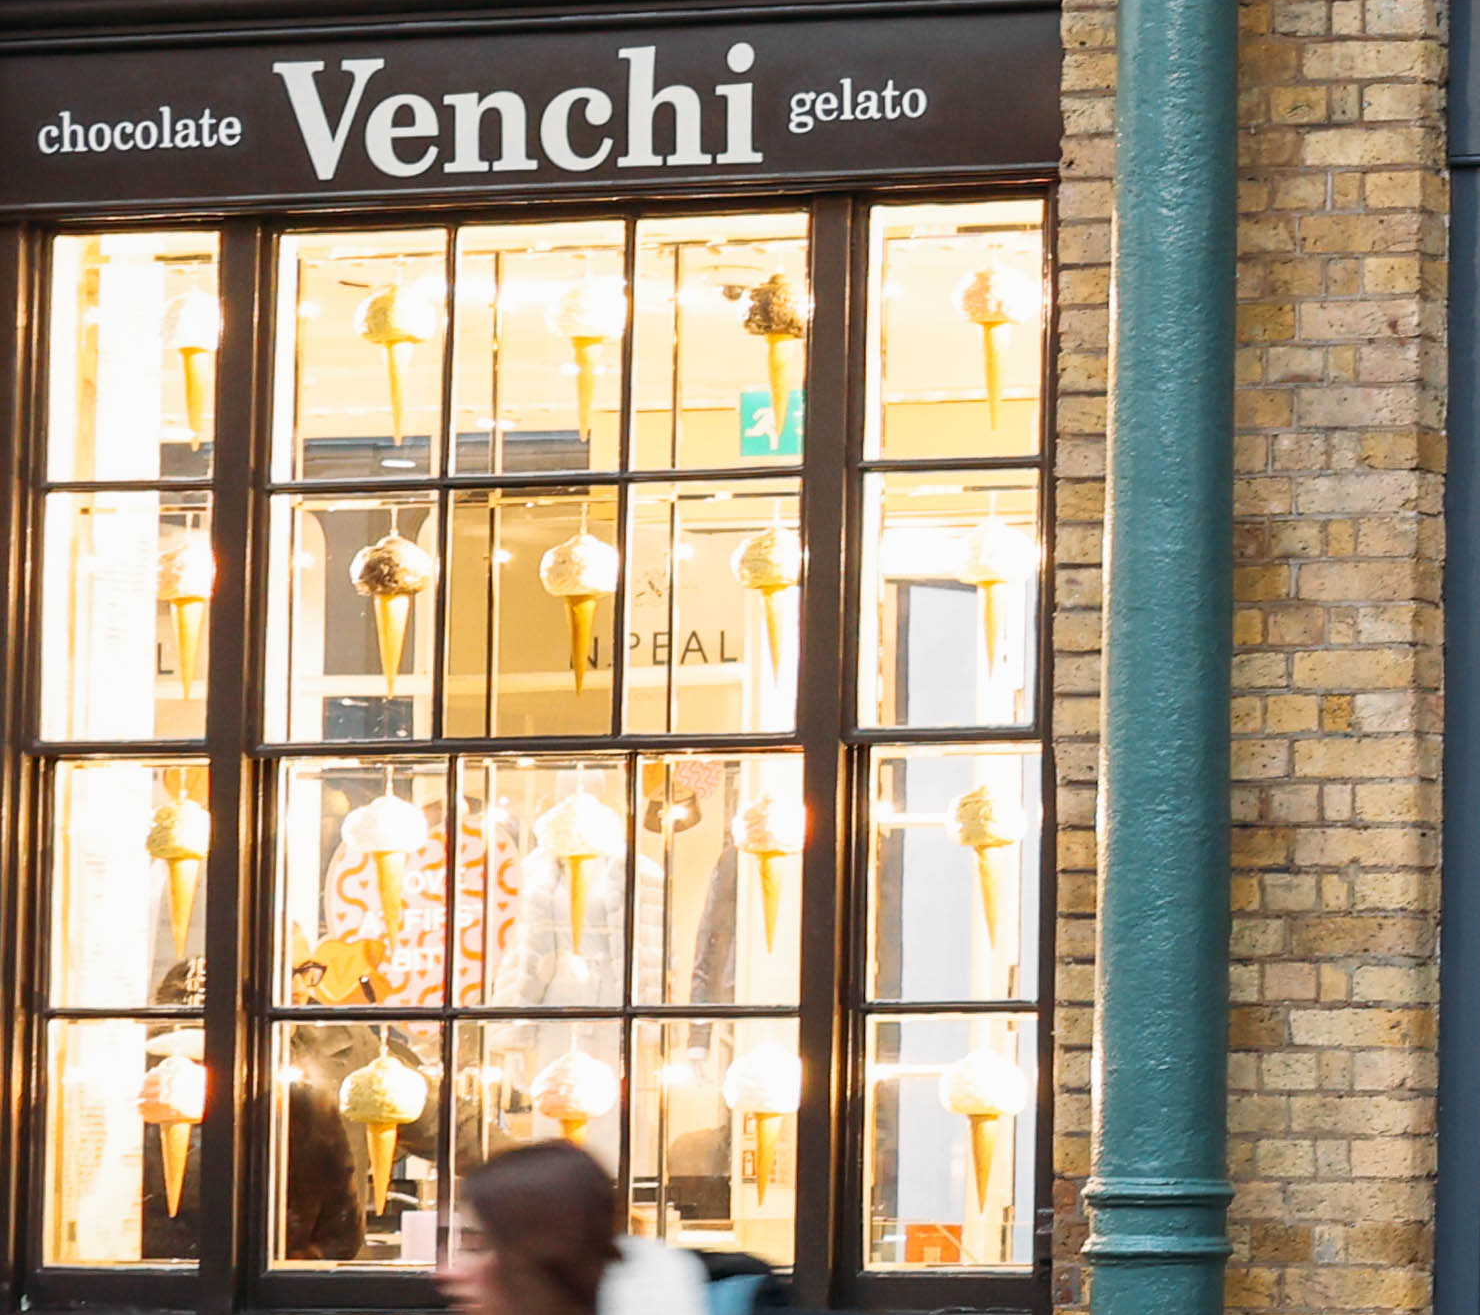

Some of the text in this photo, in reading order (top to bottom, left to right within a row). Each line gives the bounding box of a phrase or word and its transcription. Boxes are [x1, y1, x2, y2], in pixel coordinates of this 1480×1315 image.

[37, 105, 242, 154] chocolate
[272, 42, 763, 181] Venchi
[788, 77, 928, 135] gelato
